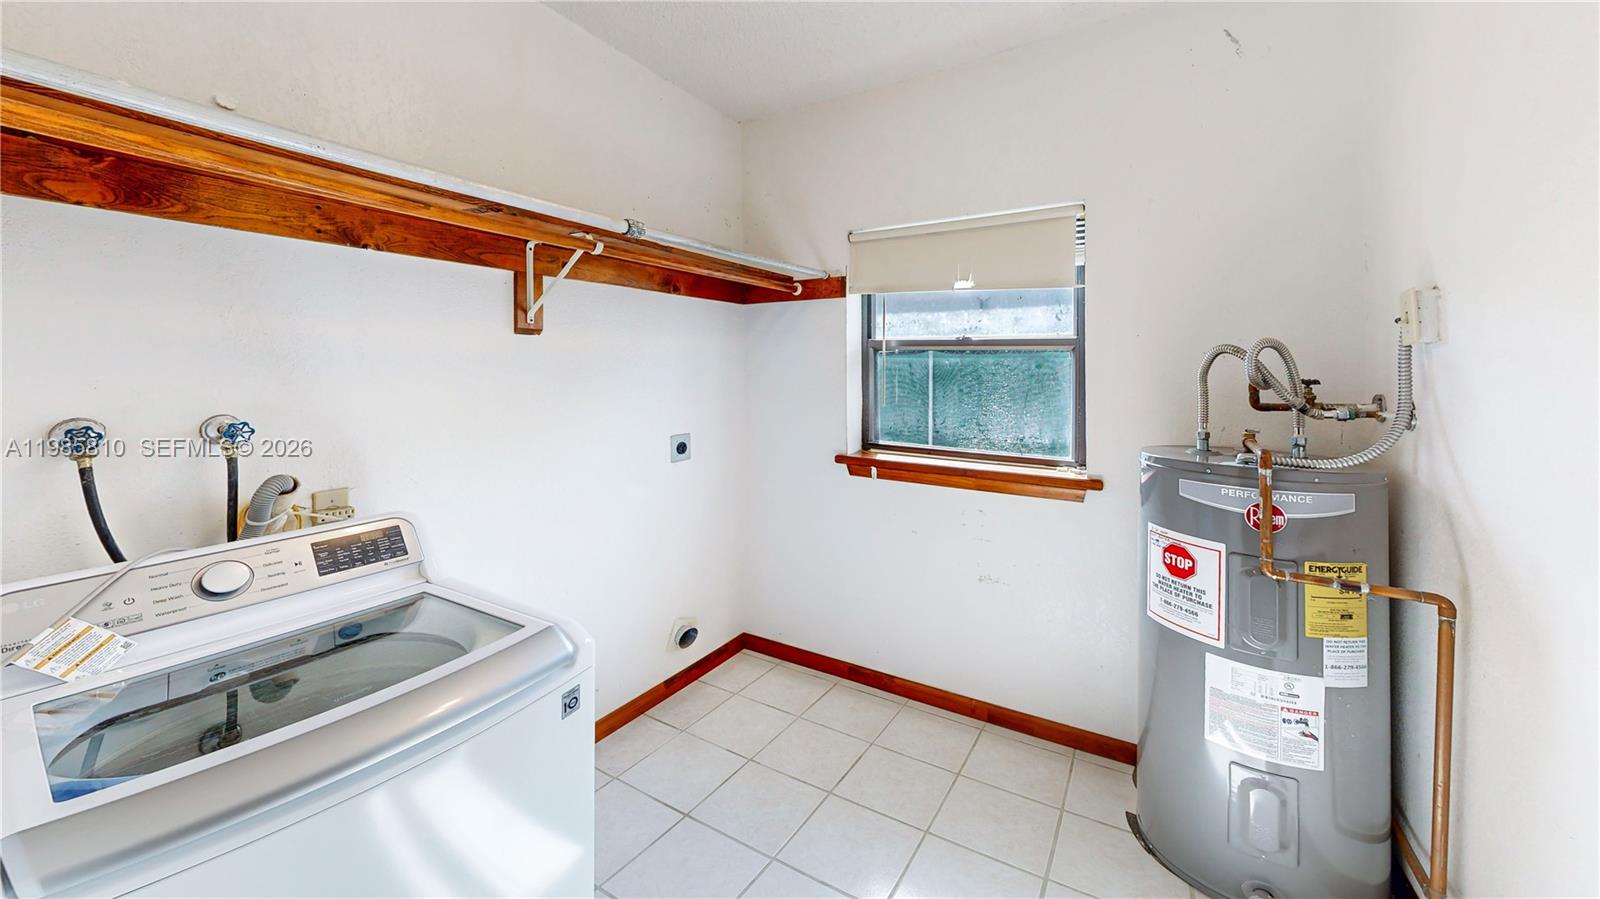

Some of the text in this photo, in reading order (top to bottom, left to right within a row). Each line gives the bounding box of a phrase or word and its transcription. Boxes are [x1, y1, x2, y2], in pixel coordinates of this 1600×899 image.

[1221, 488, 1313, 504] PERFOMANCE
[1249, 506, 1285, 528] Rem
[1164, 552, 1193, 571] STOP
[1158, 580, 1172, 589] WATER
[1173, 584, 1193, 597] HEATER
[1162, 575, 1170, 583] NOT
[1171, 579, 1191, 591] RETURN
[1193, 587, 1206, 596] THIS
[1160, 586, 1173, 596] PLACE
[1182, 594, 1213, 609] PURCHASE
[1289, 708, 1318, 716] DANGER
